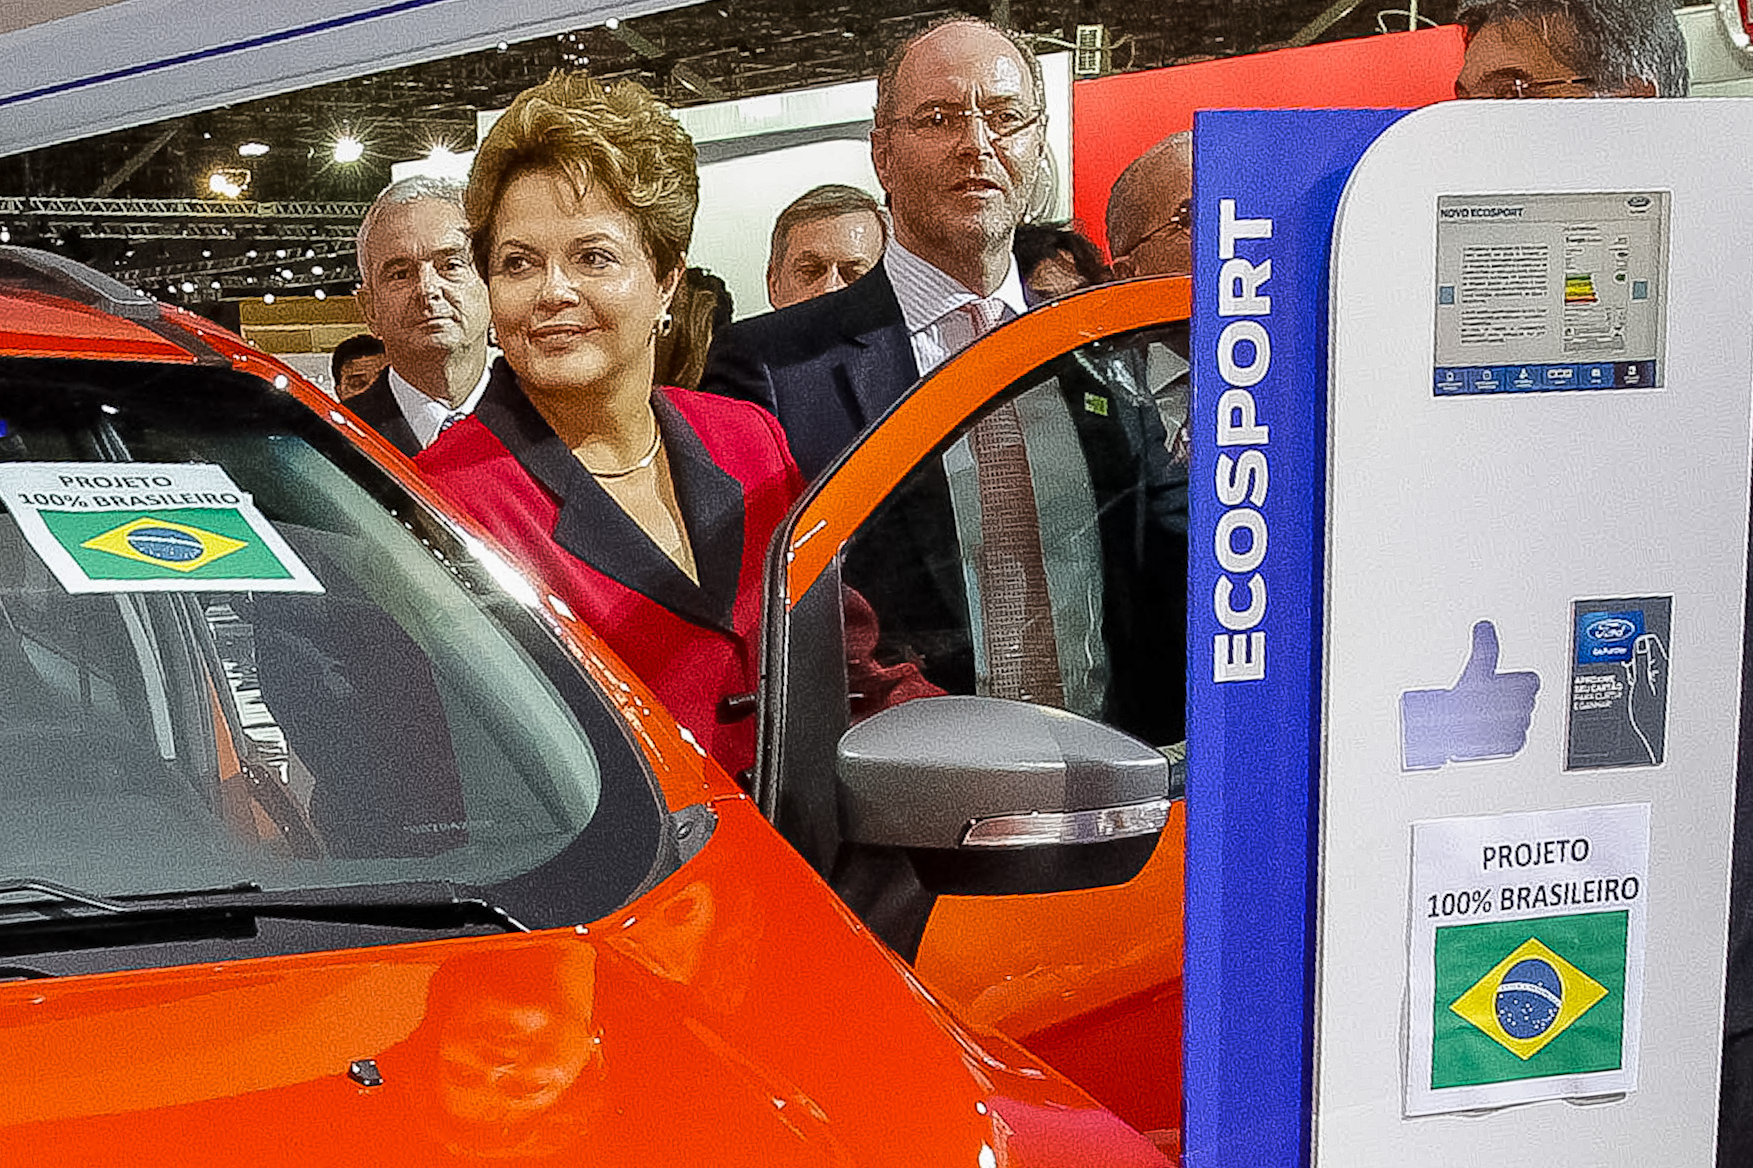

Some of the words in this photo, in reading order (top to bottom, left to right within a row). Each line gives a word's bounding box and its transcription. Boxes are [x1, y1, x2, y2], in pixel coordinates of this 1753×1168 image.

[1213, 198, 1274, 683] ECOSPORT
[58, 474, 173, 489] PROJETO
[18, 492, 88, 508] 100%
[93, 492, 241, 508] BRASILEIRO
[1483, 838, 1590, 870] PROJETO
[1428, 889, 1492, 917] 100%
[1500, 877, 1640, 911] BRASILEIRO
